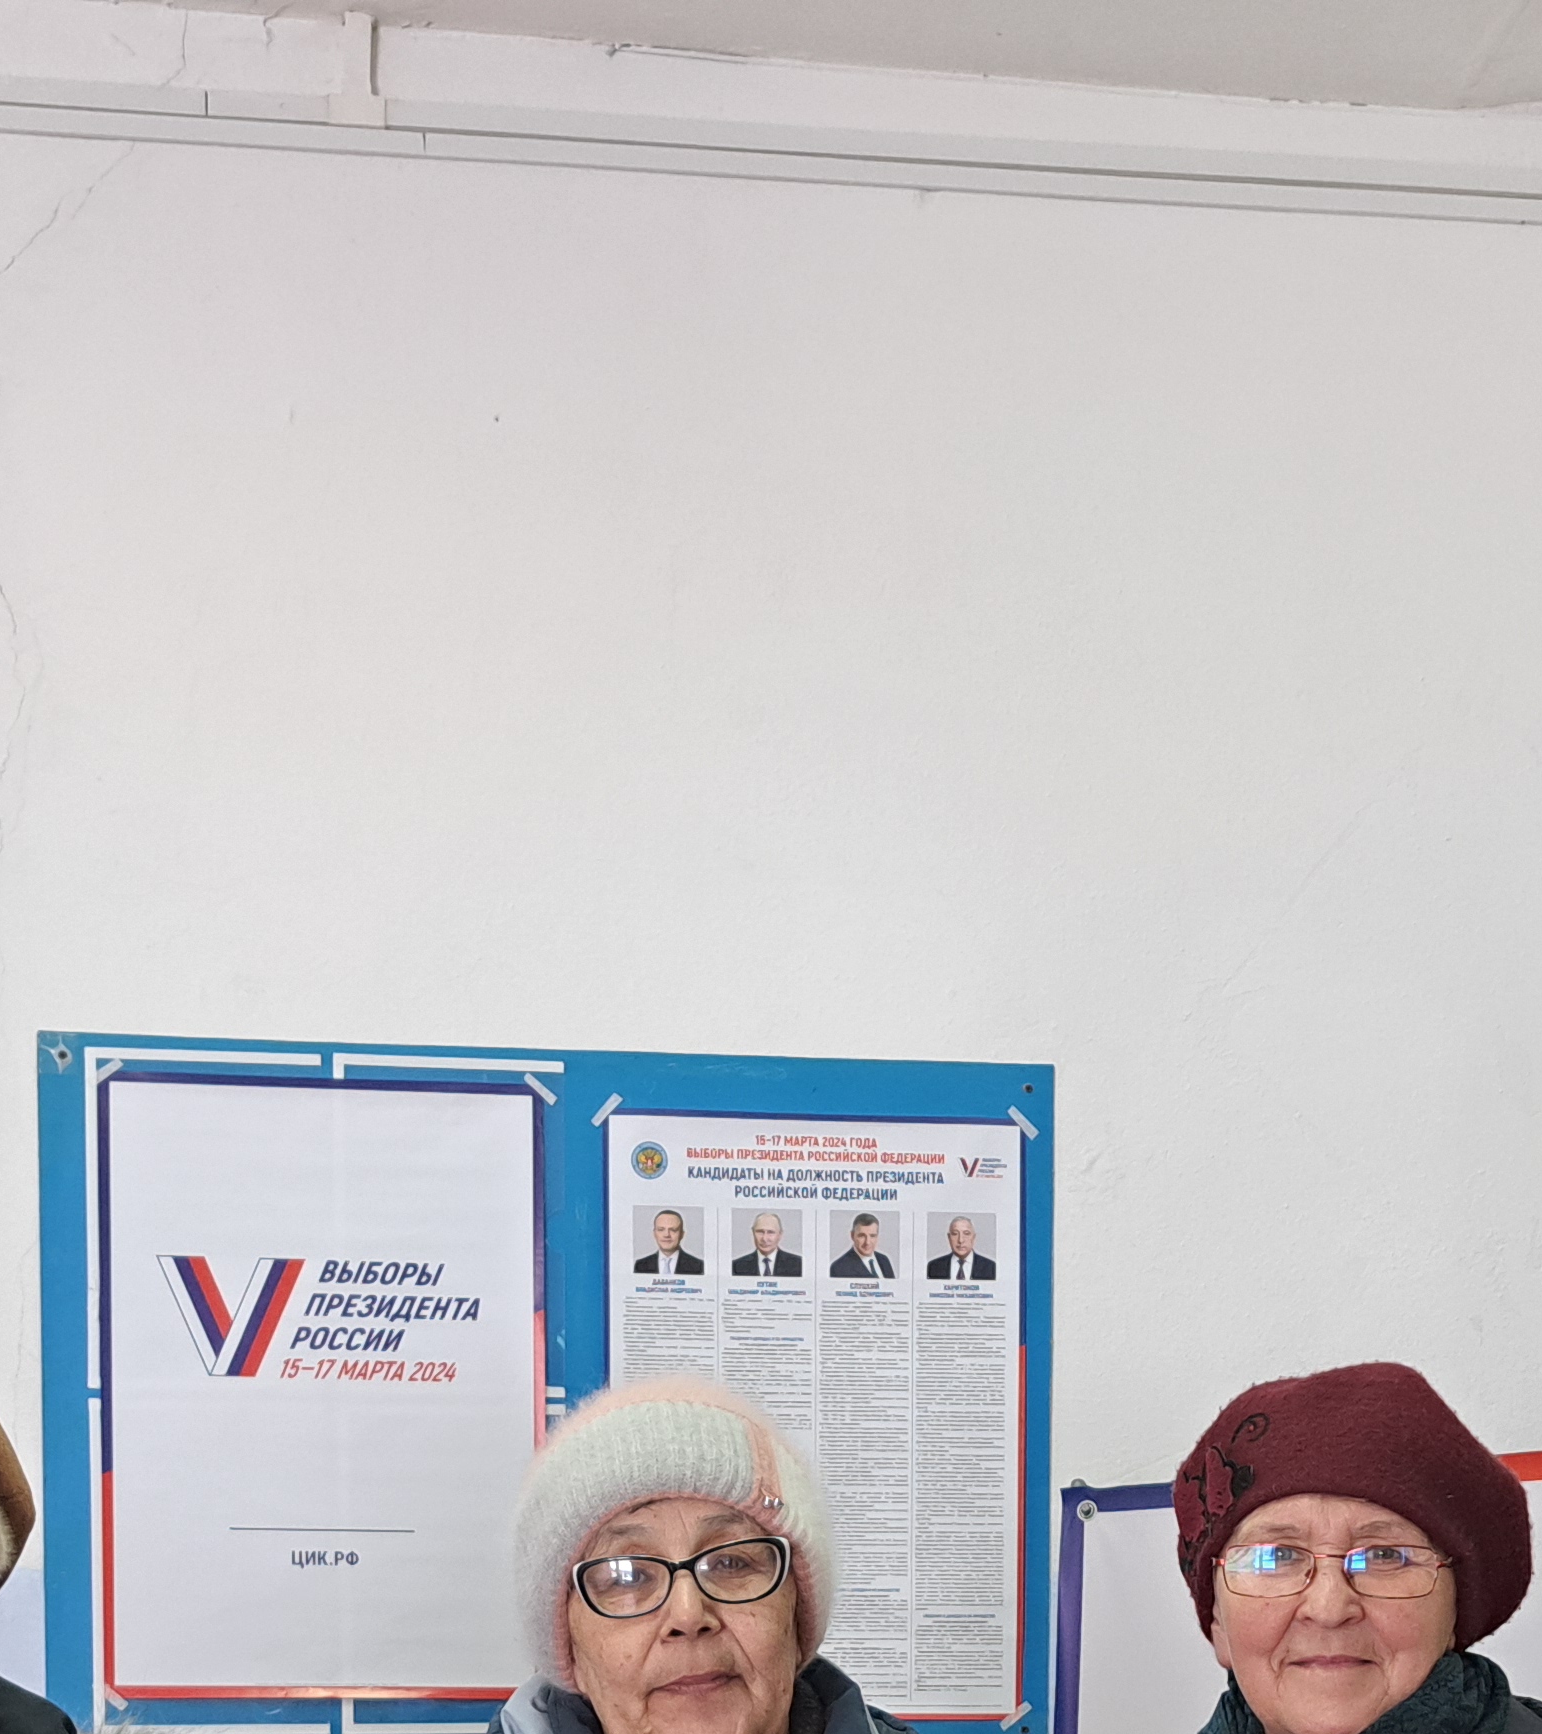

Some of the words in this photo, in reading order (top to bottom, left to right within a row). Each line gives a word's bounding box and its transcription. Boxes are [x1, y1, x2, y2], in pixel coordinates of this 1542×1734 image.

[784, 1135, 820, 1148] МАРТА
[822, 1136, 847, 1148] 2024
[849, 1137, 878, 1150] ГОДА
[686, 1147, 734, 1159] ВЫБОРЫ
[736, 1148, 805, 1162] ПРЕЗИДЕНТА
[807, 1149, 878, 1163] РОССИЙСКОЙ
[880, 1151, 945, 1165] ФЕДЕРАЦИИ
[687, 1165, 764, 1181] КАНДИДАТЫ
[767, 1168, 783, 1180] НА
[785, 1168, 864, 1183] ДОЛЖНОСТЬ
[866, 1170, 945, 1185] ПРЕЗИДЕНТА
[734, 1182, 818, 1199] РОССИЙСКОЙ
[821, 1186, 898, 1202] ФЕДЕРАЦИИ
[318, 1259, 445, 1287] ВЫБОРЫ
[304, 1293, 481, 1322] ПРЕЗИДЕНТА
[290, 1327, 405, 1352] РОССИИ
[337, 1359, 405, 1381] МАРТА
[408, 1361, 457, 1383] 2024
[291, 1550, 360, 1569] ЦИК.РФ
